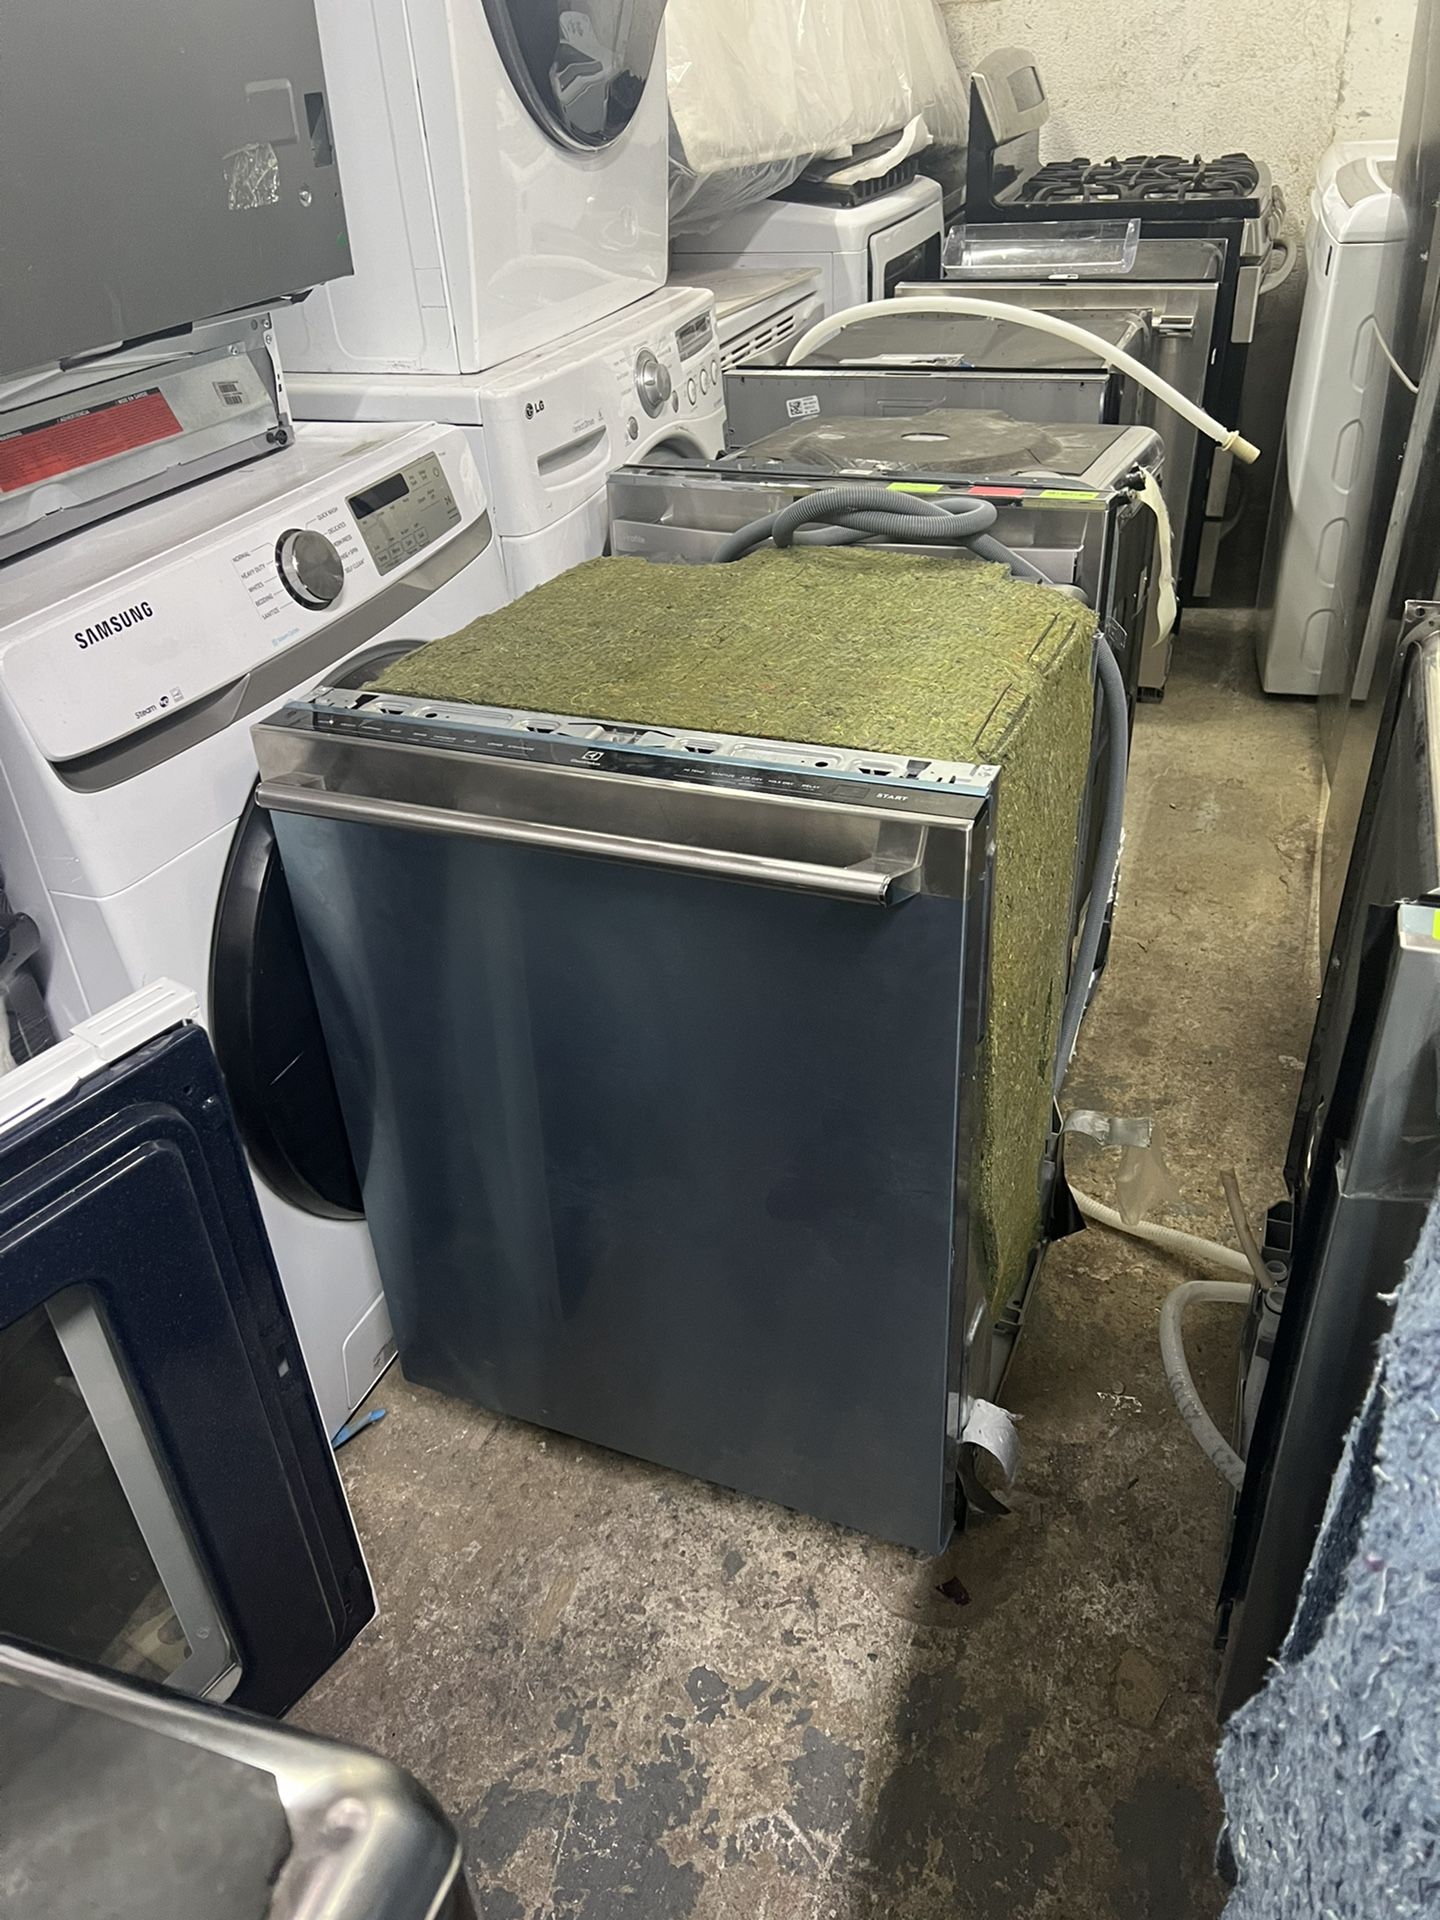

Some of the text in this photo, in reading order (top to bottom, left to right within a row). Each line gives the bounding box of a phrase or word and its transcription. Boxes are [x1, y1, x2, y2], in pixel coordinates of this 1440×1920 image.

[74, 602, 153, 649] SAMSUNG
[134, 704, 157, 719] Steam
[876, 792, 909, 801] START
